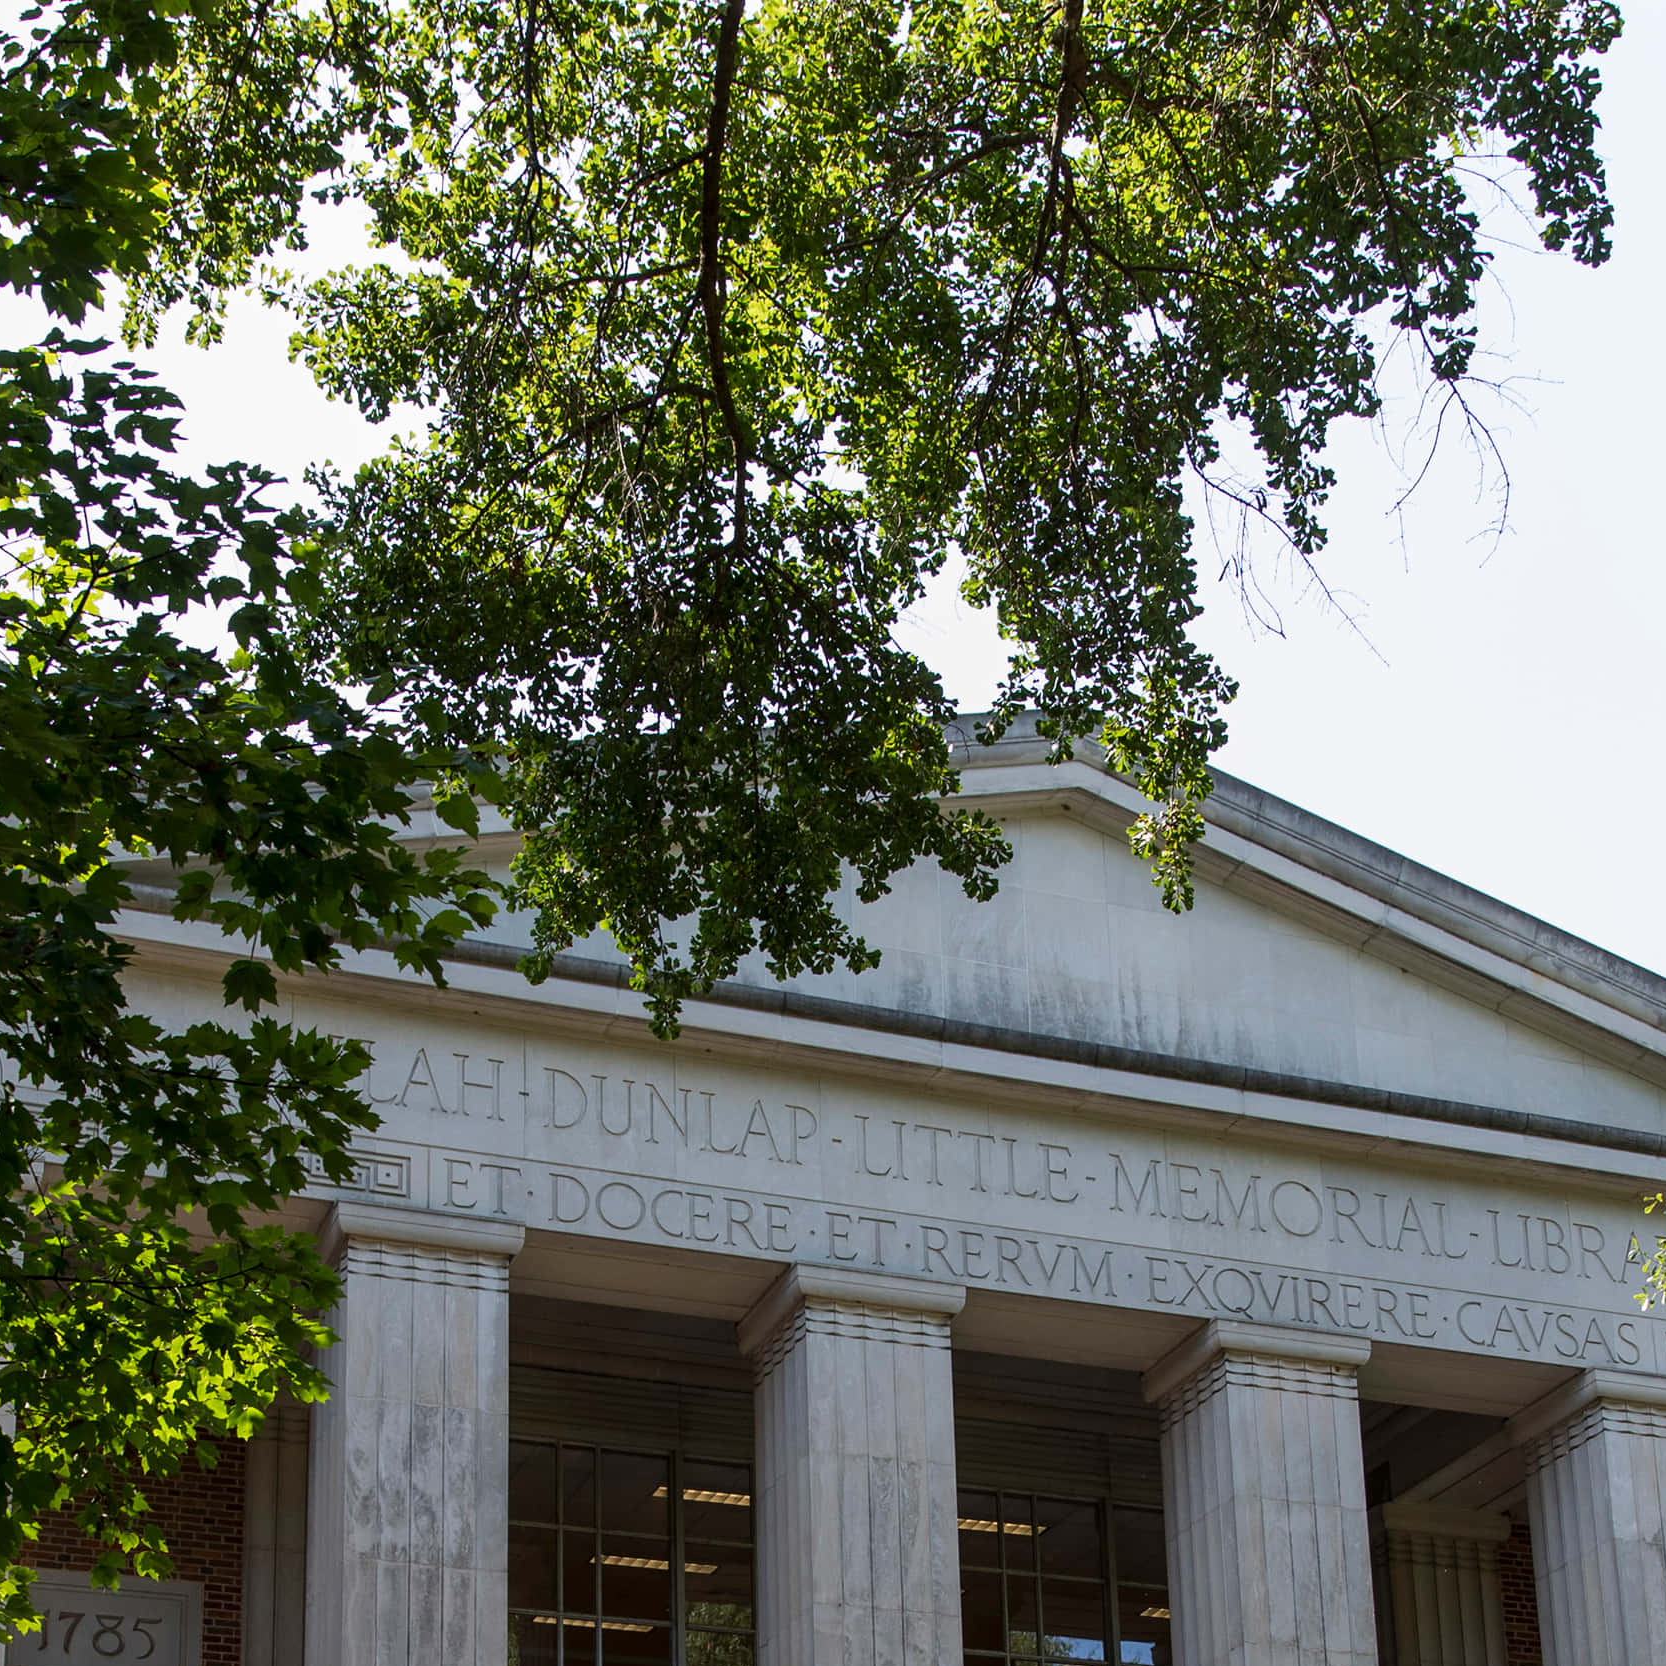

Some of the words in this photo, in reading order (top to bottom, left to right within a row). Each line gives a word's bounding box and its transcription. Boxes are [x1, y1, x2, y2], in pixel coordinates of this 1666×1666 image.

[328, 1034, 505, 1122] LAH
[543, 1066, 818, 1165] DUNLAP
[853, 1113, 1080, 1204] LITTLE
[1107, 1151, 1469, 1260] MEMORIAL
[442, 1157, 523, 1215] ET
[548, 1171, 798, 1254] DOCERE
[824, 1211, 898, 1266] ET
[918, 1224, 1118, 1299] RERVM
[1144, 1254, 1439, 1339] EXQVIRERE
[1455, 1300, 1641, 1366] CAVSAS
[36, 1608, 163, 1660] 1785
